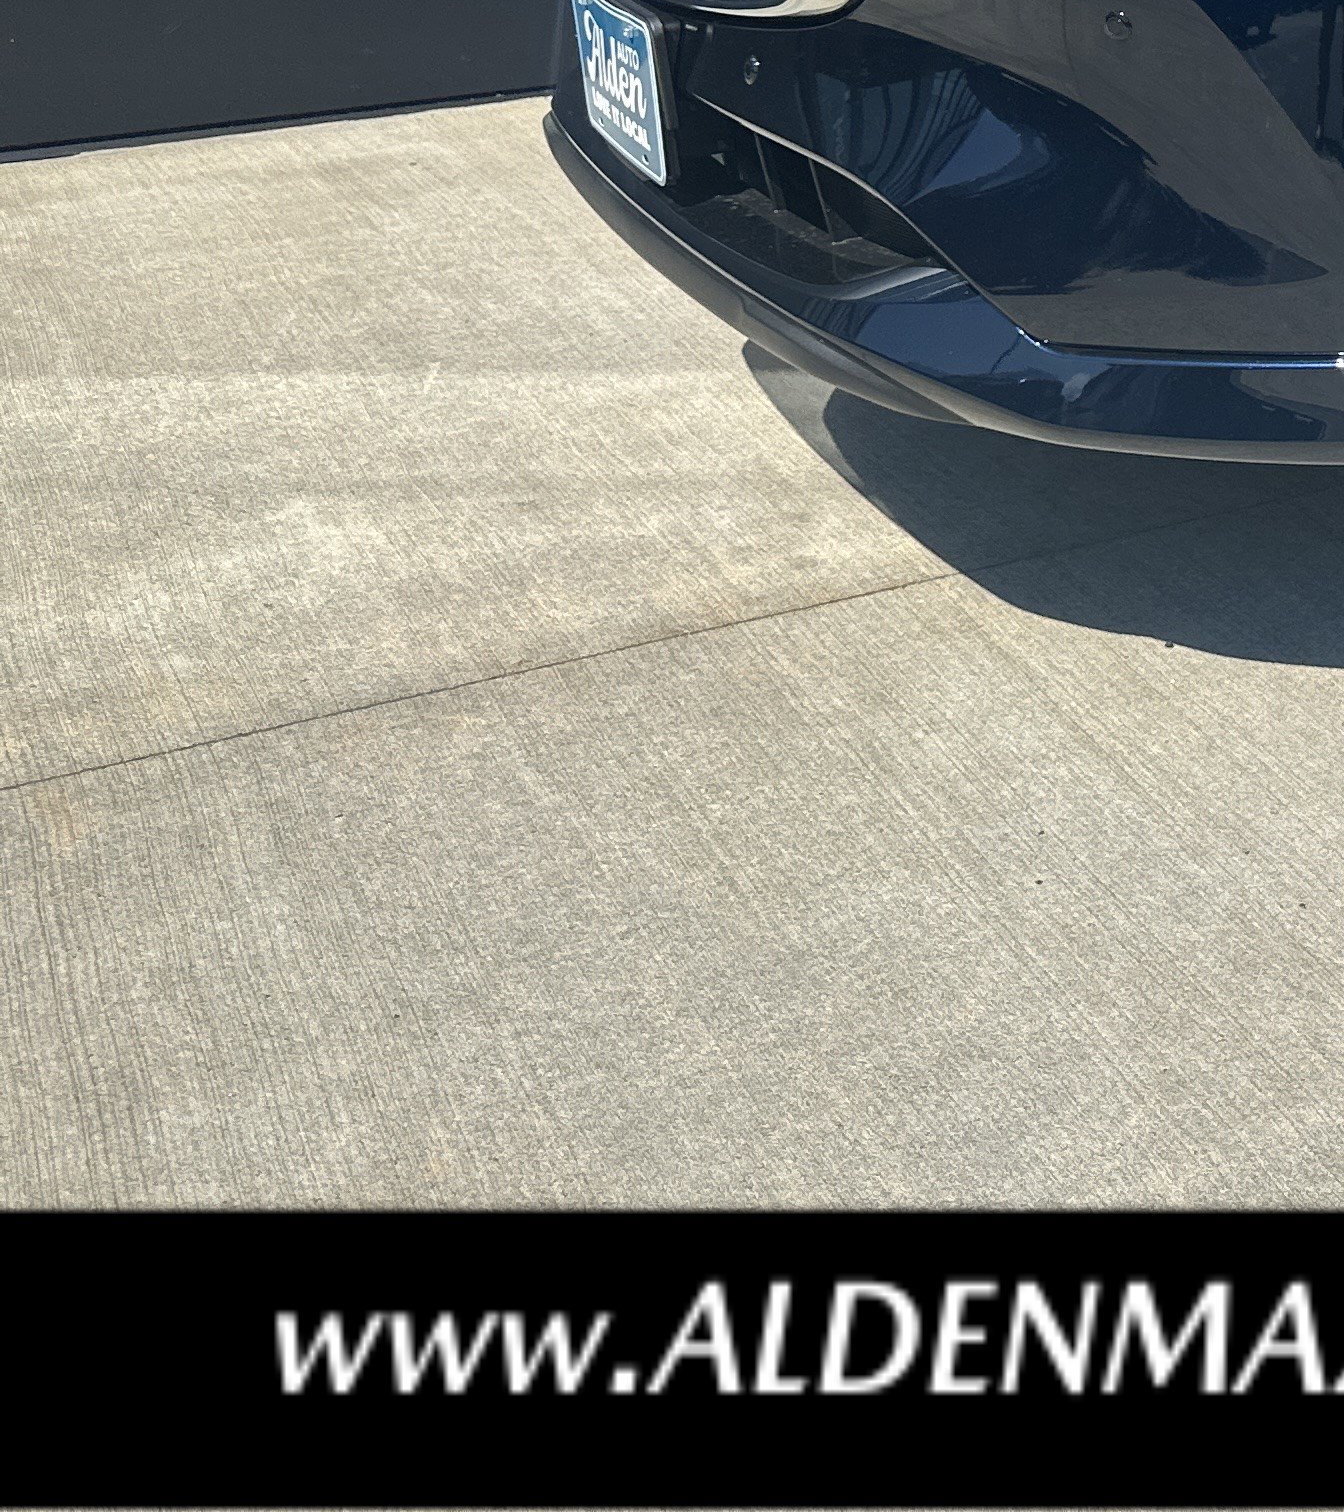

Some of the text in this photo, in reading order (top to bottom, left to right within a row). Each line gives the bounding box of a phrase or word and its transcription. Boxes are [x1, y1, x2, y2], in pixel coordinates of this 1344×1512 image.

[584, 9, 648, 120] Alden
[617, 40, 640, 71] AUTO
[620, 112, 652, 152] LOCAL
